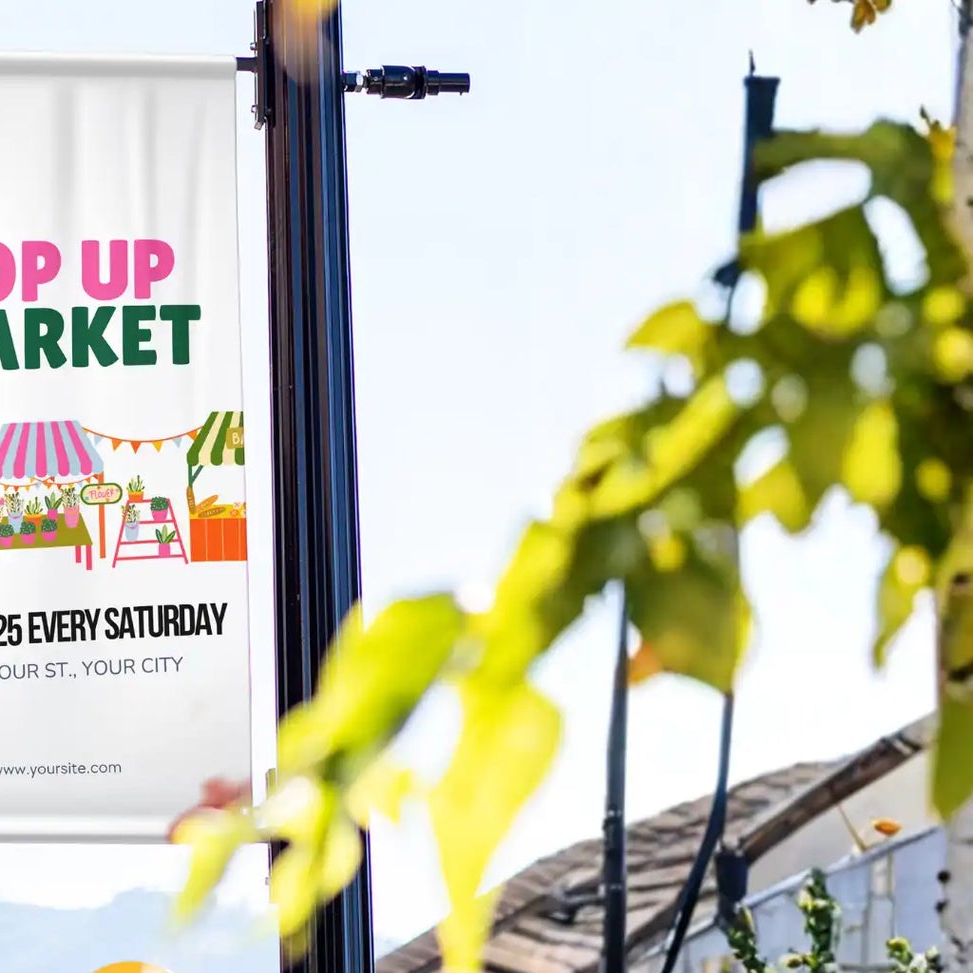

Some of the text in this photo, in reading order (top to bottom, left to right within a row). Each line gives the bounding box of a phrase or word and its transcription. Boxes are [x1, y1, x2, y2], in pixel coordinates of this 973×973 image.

[81, 238, 175, 300] UP
[28, 608, 101, 644] EVERY
[104, 602, 228, 640] SATURDAY
[45, 661, 78, 680] ST.,
[82, 658, 136, 677] YOUR
[141, 656, 184, 674] CITY
